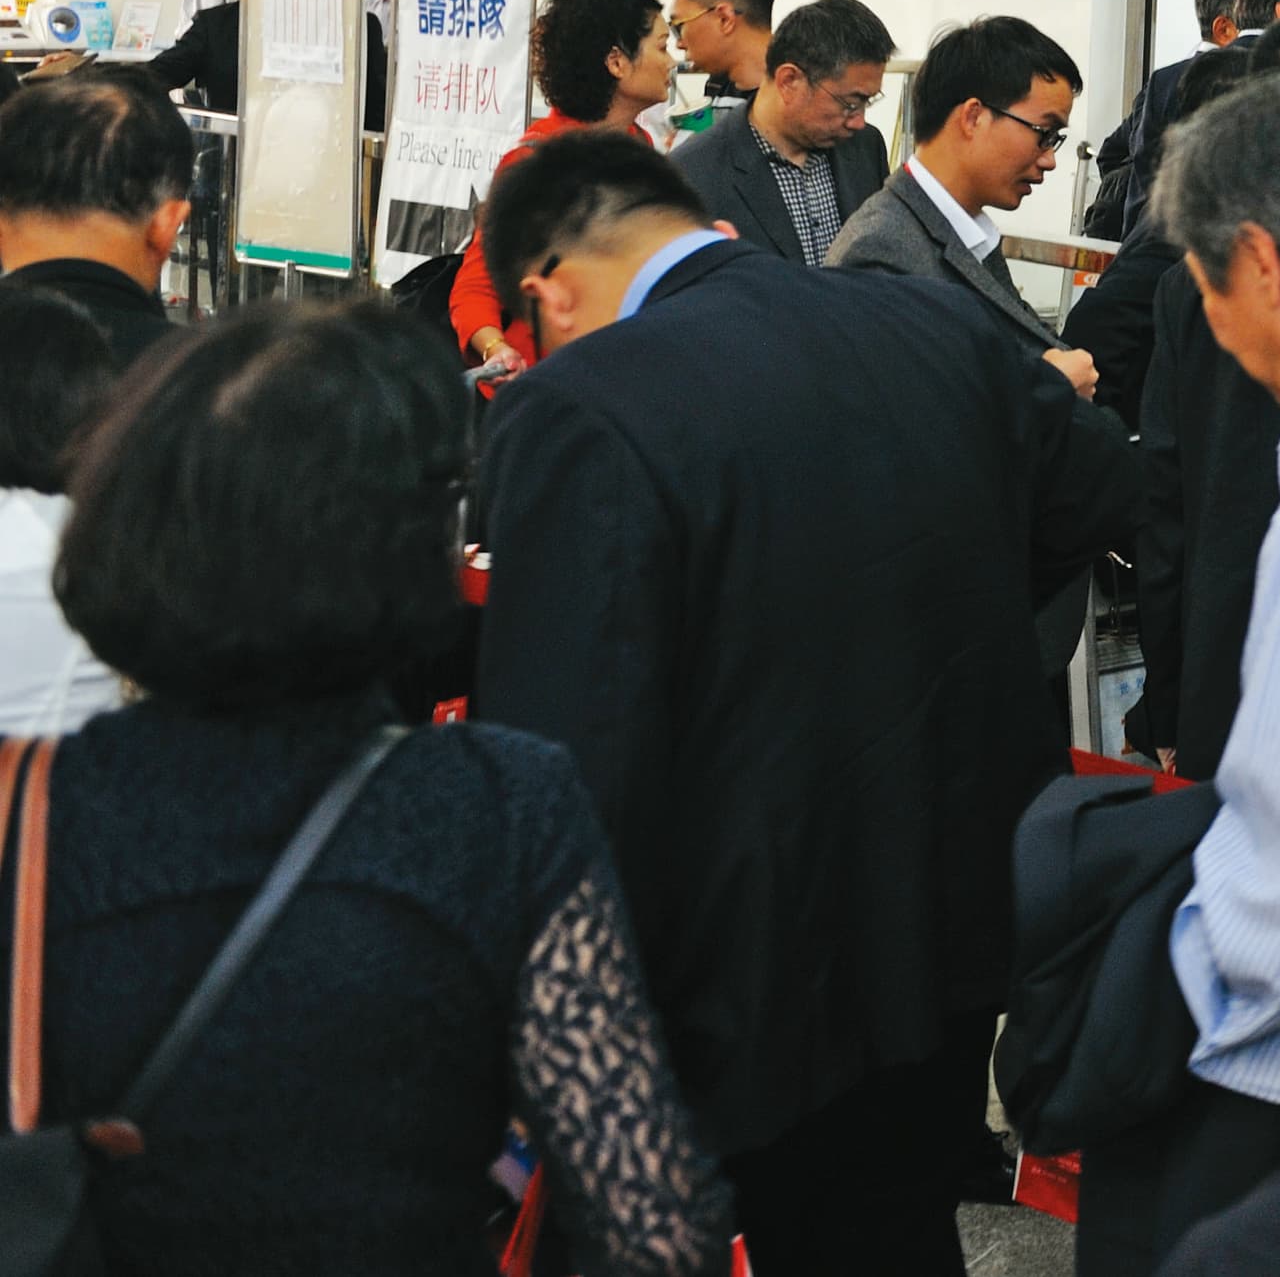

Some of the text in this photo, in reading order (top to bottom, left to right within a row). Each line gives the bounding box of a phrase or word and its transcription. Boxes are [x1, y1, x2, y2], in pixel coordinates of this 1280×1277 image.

[414, 62, 502, 115] 请排队
[397, 131, 448, 166] Please
[453, 137, 482, 171] line
